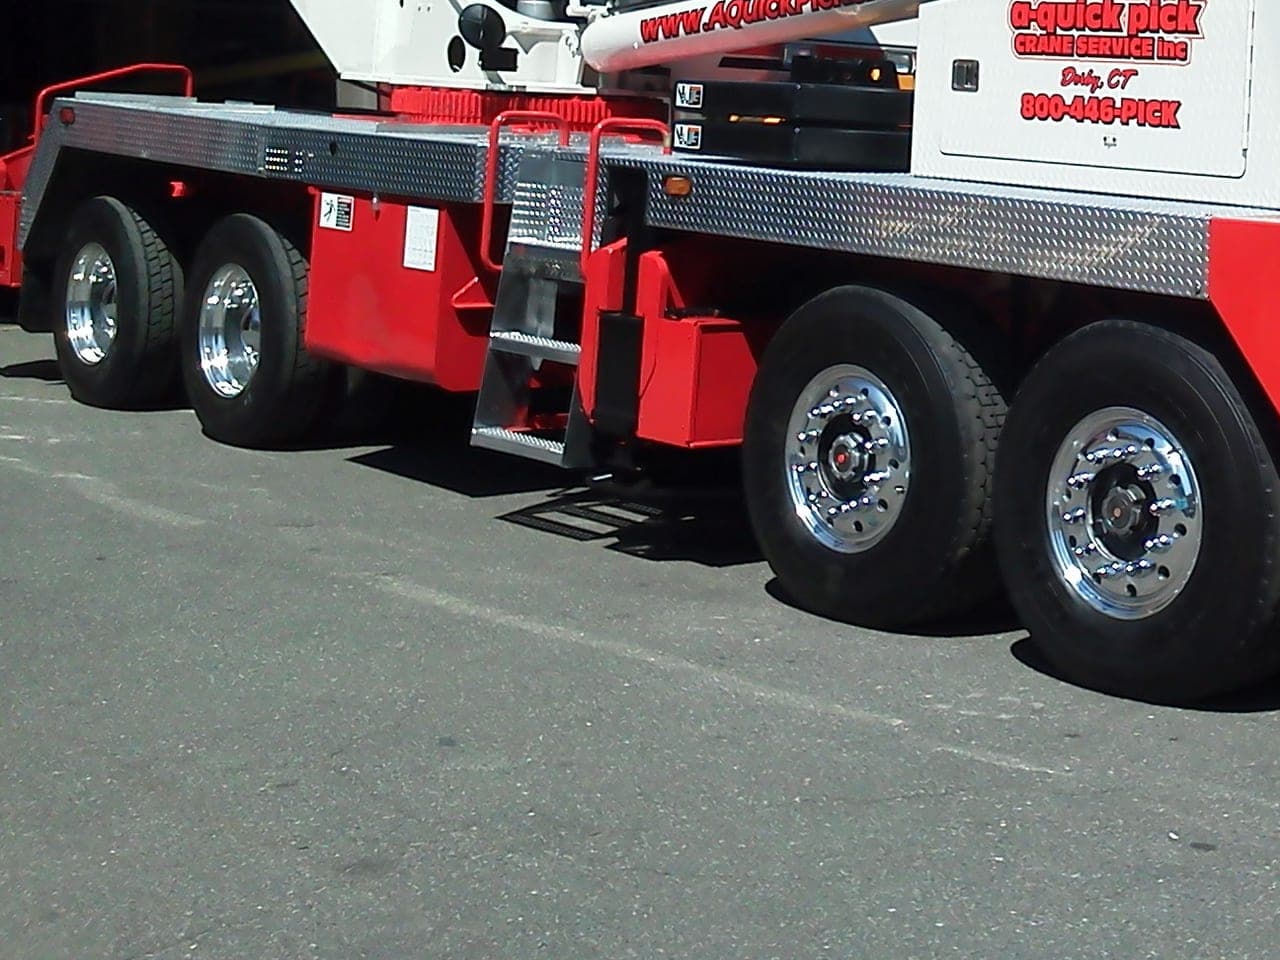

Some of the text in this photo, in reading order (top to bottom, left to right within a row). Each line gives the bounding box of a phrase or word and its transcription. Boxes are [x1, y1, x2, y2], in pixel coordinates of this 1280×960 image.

[1013, 33, 1189, 61] CRANE SERVICE inc
[1107, 68, 1139, 90] CT
[1020, 92, 1182, 129] 800-446-PICK
